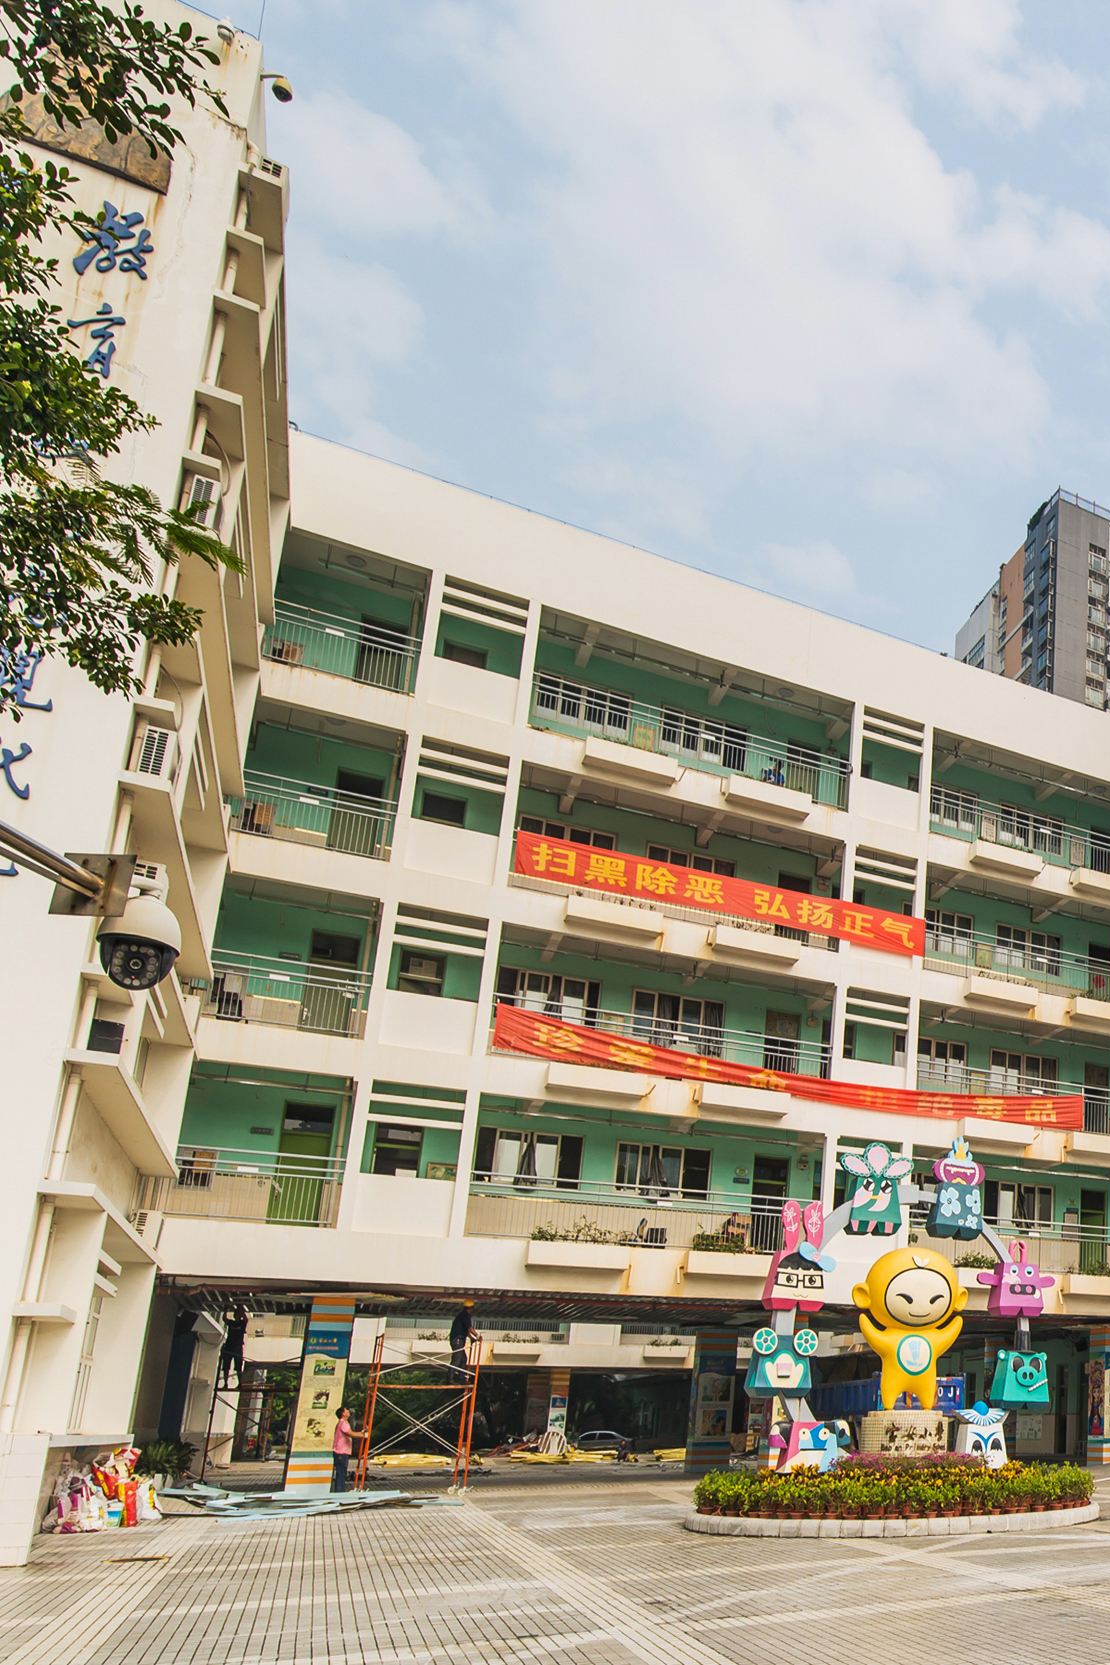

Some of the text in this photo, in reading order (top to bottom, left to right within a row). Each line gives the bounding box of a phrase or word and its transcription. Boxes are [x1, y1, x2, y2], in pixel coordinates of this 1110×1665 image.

[532, 842, 915, 948] 扫黑除恶 弘扬正气
